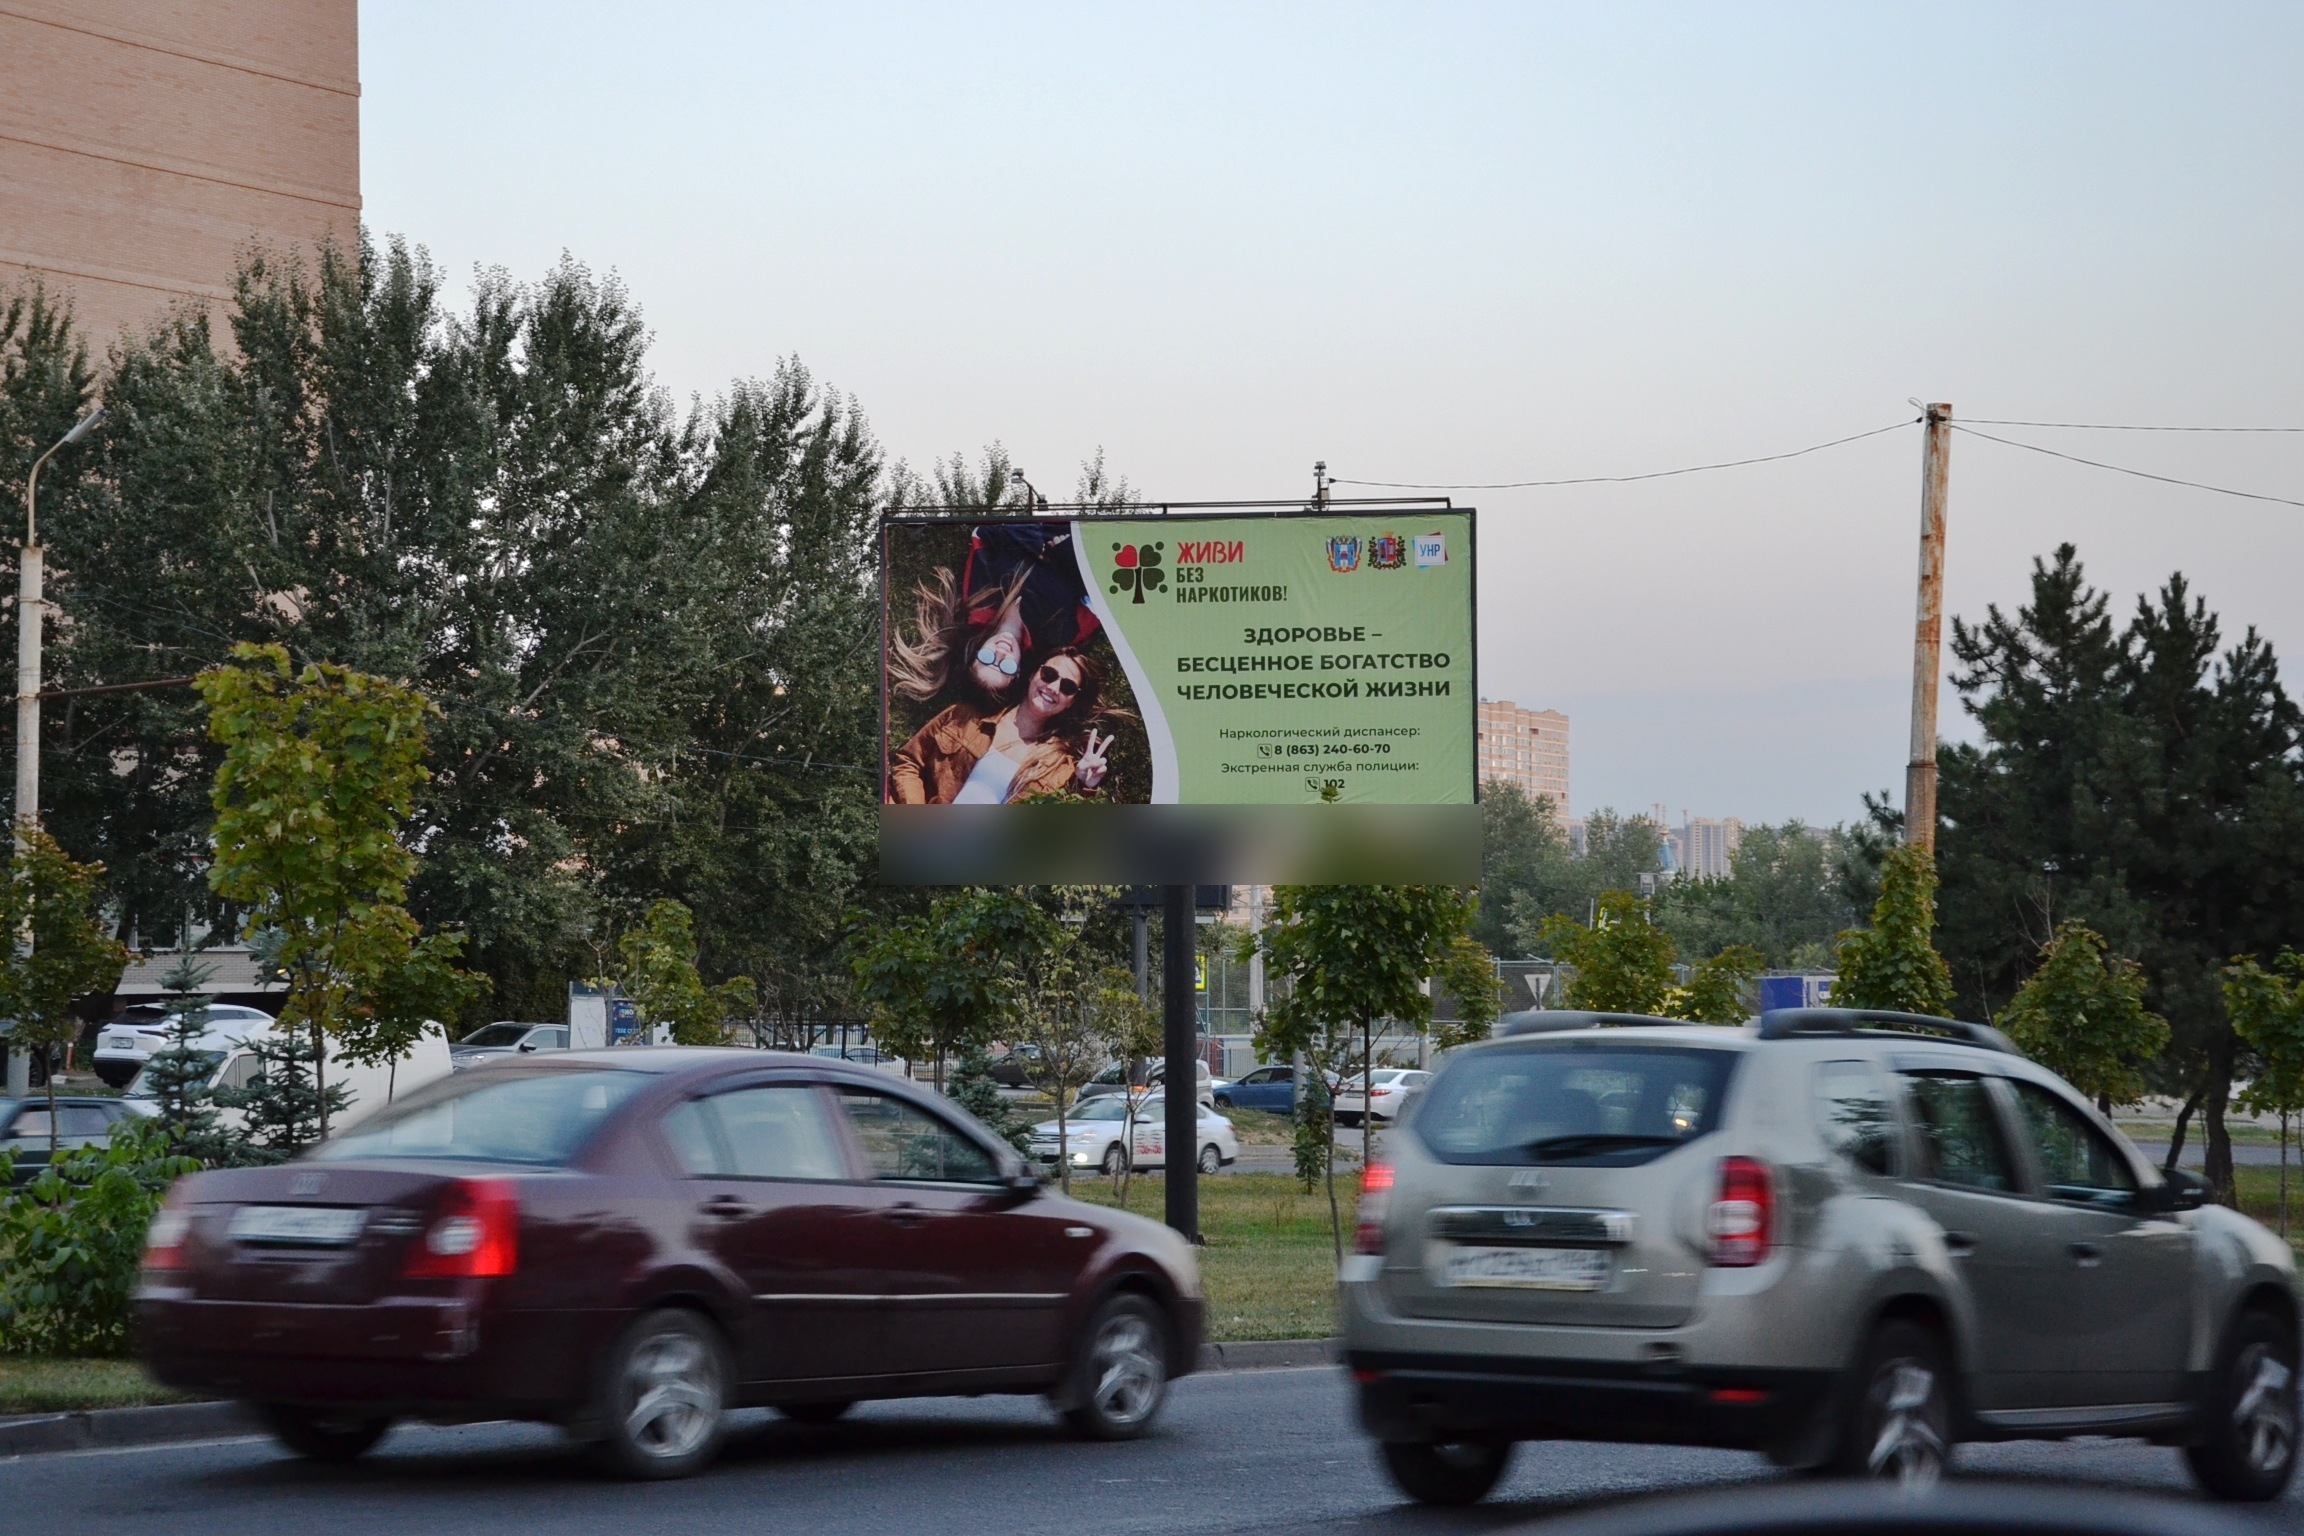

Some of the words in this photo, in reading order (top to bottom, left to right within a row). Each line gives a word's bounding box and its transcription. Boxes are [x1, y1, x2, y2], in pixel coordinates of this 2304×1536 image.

[1177, 540, 1244, 564] ЖИВИ
[1419, 544, 1440, 556] УНР
[1176, 567, 1204, 583] БЕЗ
[1176, 586, 1288, 603] НАРКОТИКОВ!
[1243, 627, 1366, 646] ЗДОРОВЬЕ
[1177, 655, 1314, 674] БЕСЦЕННОЕ
[1320, 653, 1451, 670] БОГАТСТВО
[1177, 678, 1359, 700] ЧЕЛОВЕЧЕСКОЙ
[1365, 681, 1450, 697] ЖИЗНИ
[1219, 727, 1340, 740] Наркологический
[1344, 726, 1421, 738] диспансер:
[1274, 745, 1283, 755] 8
[1286, 744, 1320, 757] (863)
[1323, 743, 1391, 755] 240-60-70
[1221, 763, 1300, 774] Экстренная
[1303, 761, 1352, 774] служба
[1356, 761, 1420, 772] полиции:
